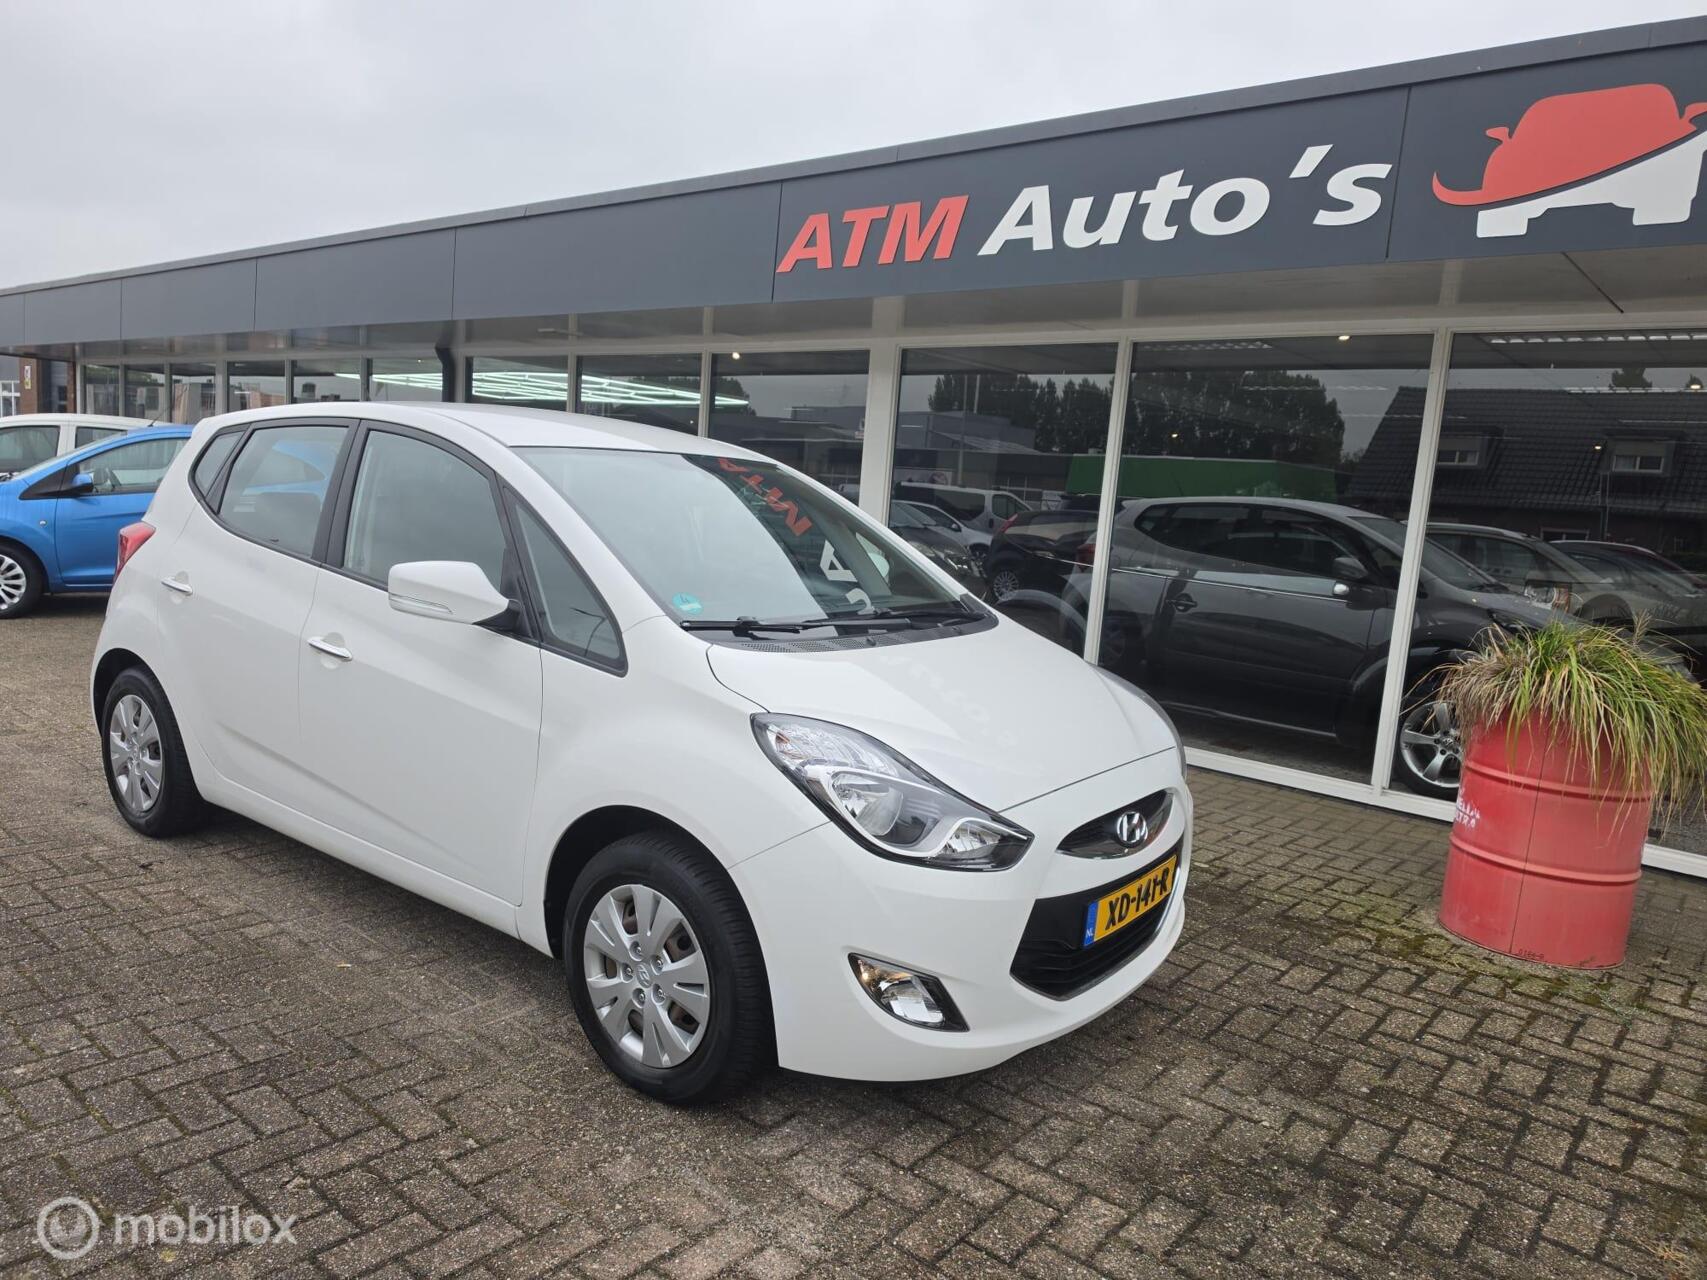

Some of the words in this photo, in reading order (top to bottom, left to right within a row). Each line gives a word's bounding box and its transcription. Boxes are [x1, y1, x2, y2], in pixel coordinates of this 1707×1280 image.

[776, 195, 969, 273] ATM
[977, 143, 1393, 256] Auto's
[1105, 867, 1170, 930] XD-141-R
[1085, 928, 1094, 939] NL
